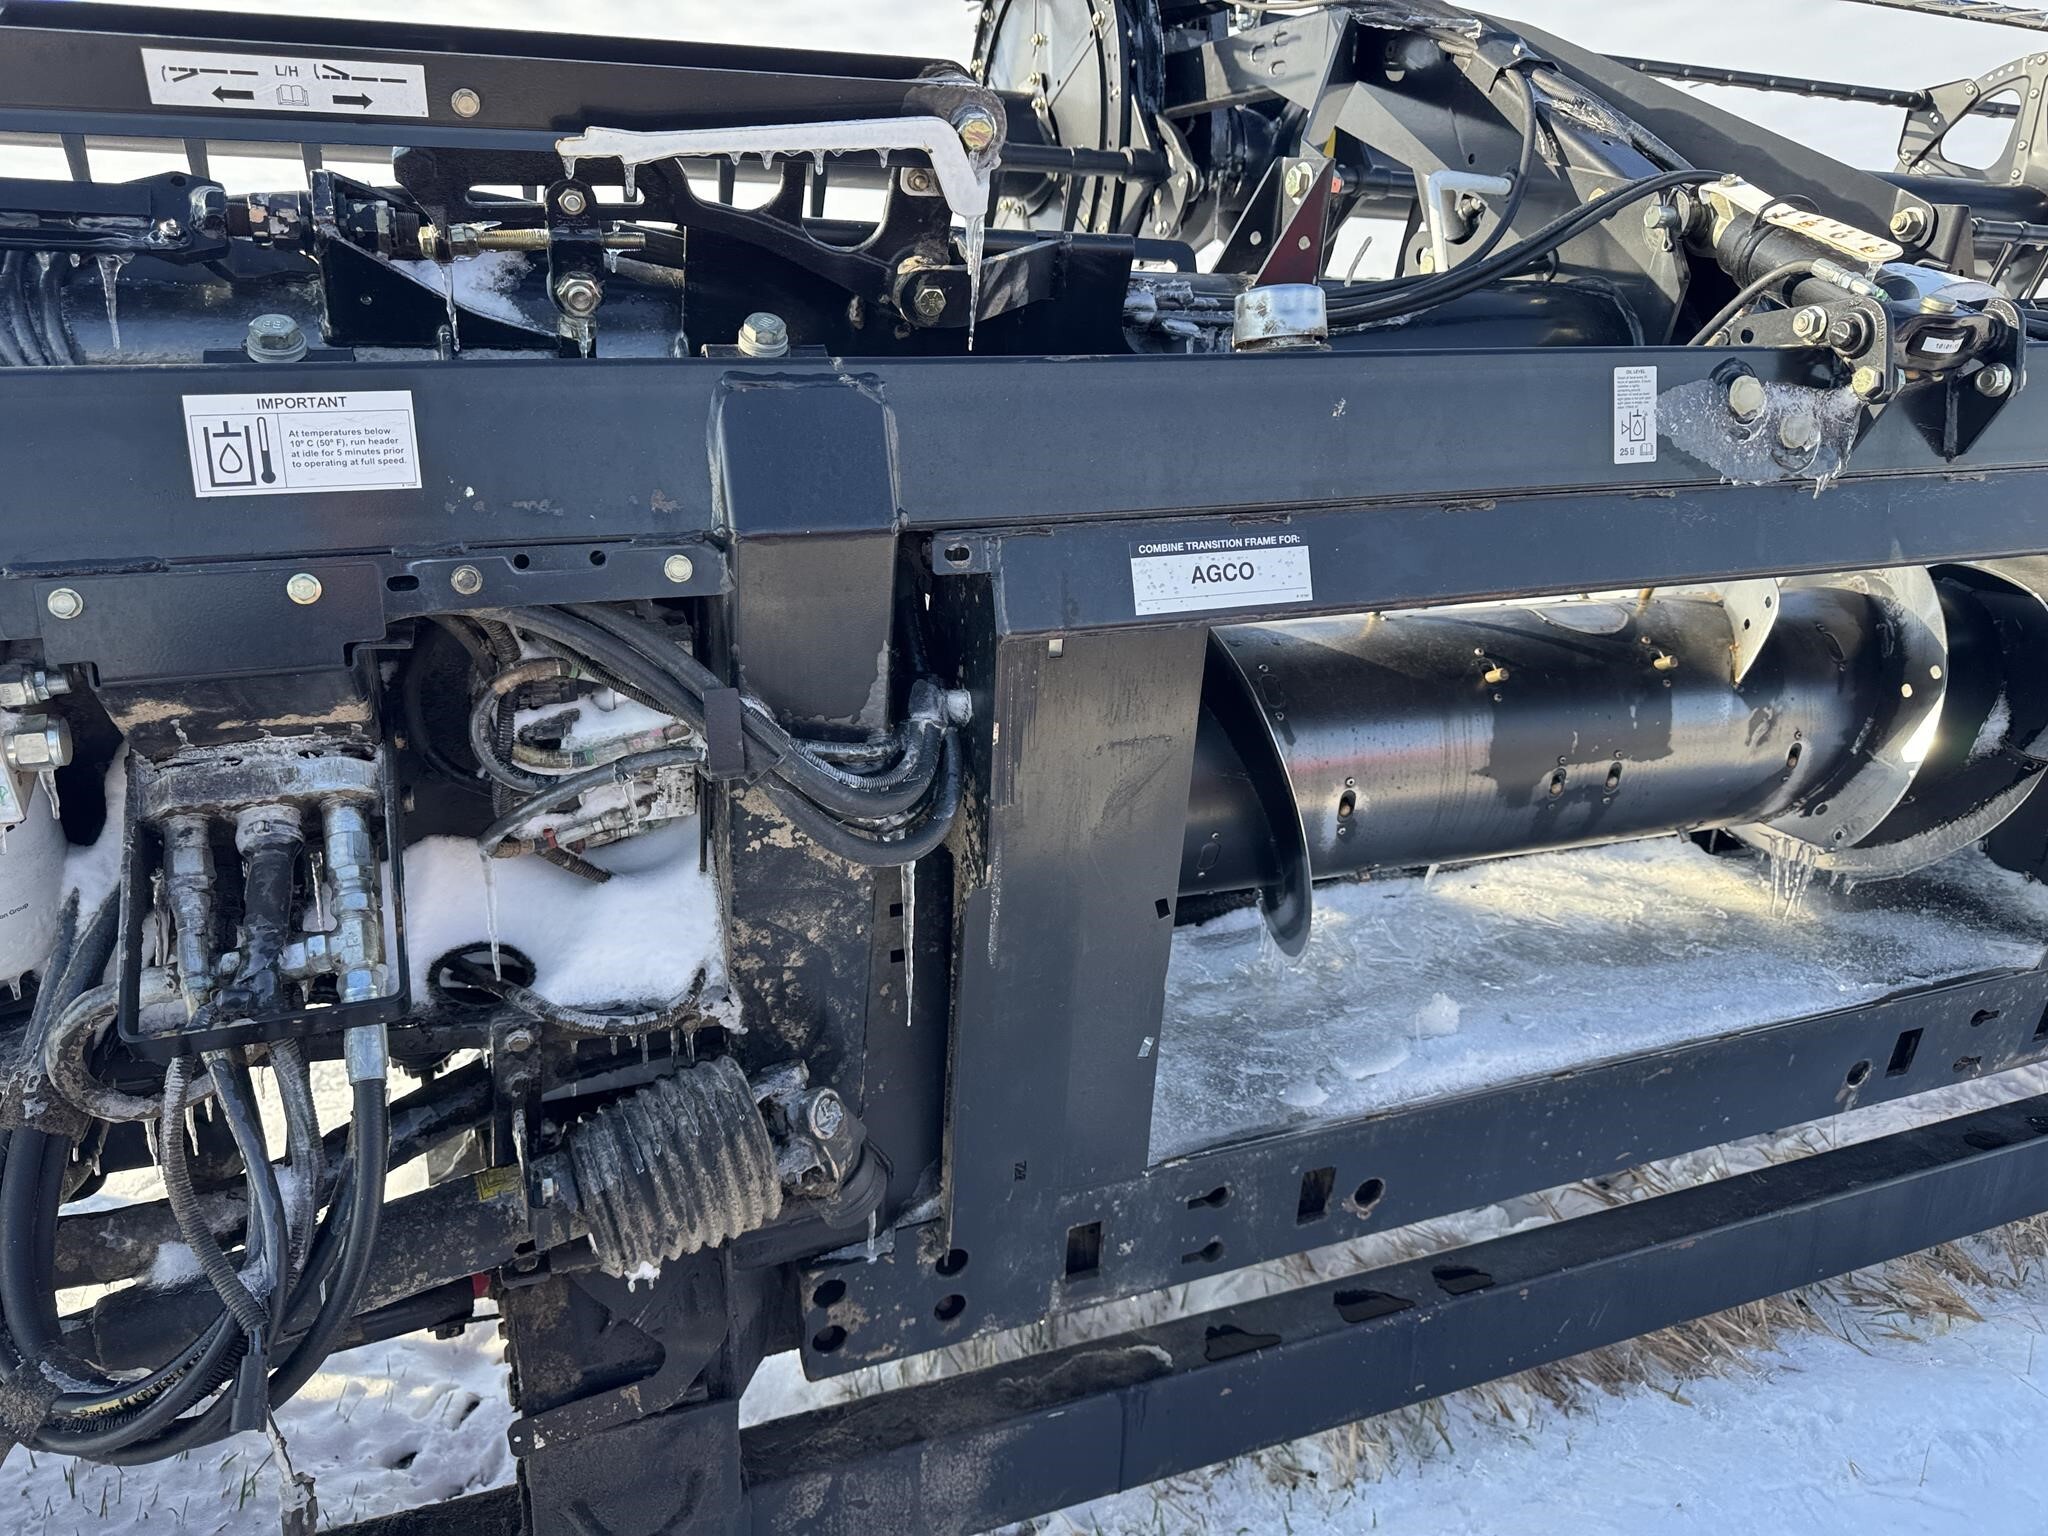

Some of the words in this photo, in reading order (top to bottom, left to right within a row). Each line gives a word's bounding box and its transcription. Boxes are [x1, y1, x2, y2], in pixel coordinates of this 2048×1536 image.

[275, 64, 299, 77] L/H
[256, 396, 347, 410] IMPORTANT
[288, 429, 299, 437] At
[301, 429, 362, 438] temperatures
[364, 427, 391, 435] below
[306, 439, 314, 447] C
[368, 436, 399, 445] header
[291, 450, 300, 458] at
[302, 449, 319, 457] idle
[321, 449, 334, 457] for
[336, 448, 342, 456] 5
[344, 448, 380, 456] minutes
[383, 447, 404, 456] prior
[1619, 447, 1629, 456] 25
[292, 460, 302, 468] to
[304, 459, 348, 469] operating
[350, 458, 359, 466] at
[360, 457, 375, 465] full
[377, 456, 407, 466] speed.
[1138, 542, 1184, 554] COMBINE
[1186, 538, 1243, 551] TRANSITION
[1244, 536, 1277, 547] FRAME
[1278, 534, 1301, 544] FOR:
[1191, 561, 1255, 584] AGCO
[8, 902, 29, 916] Group
